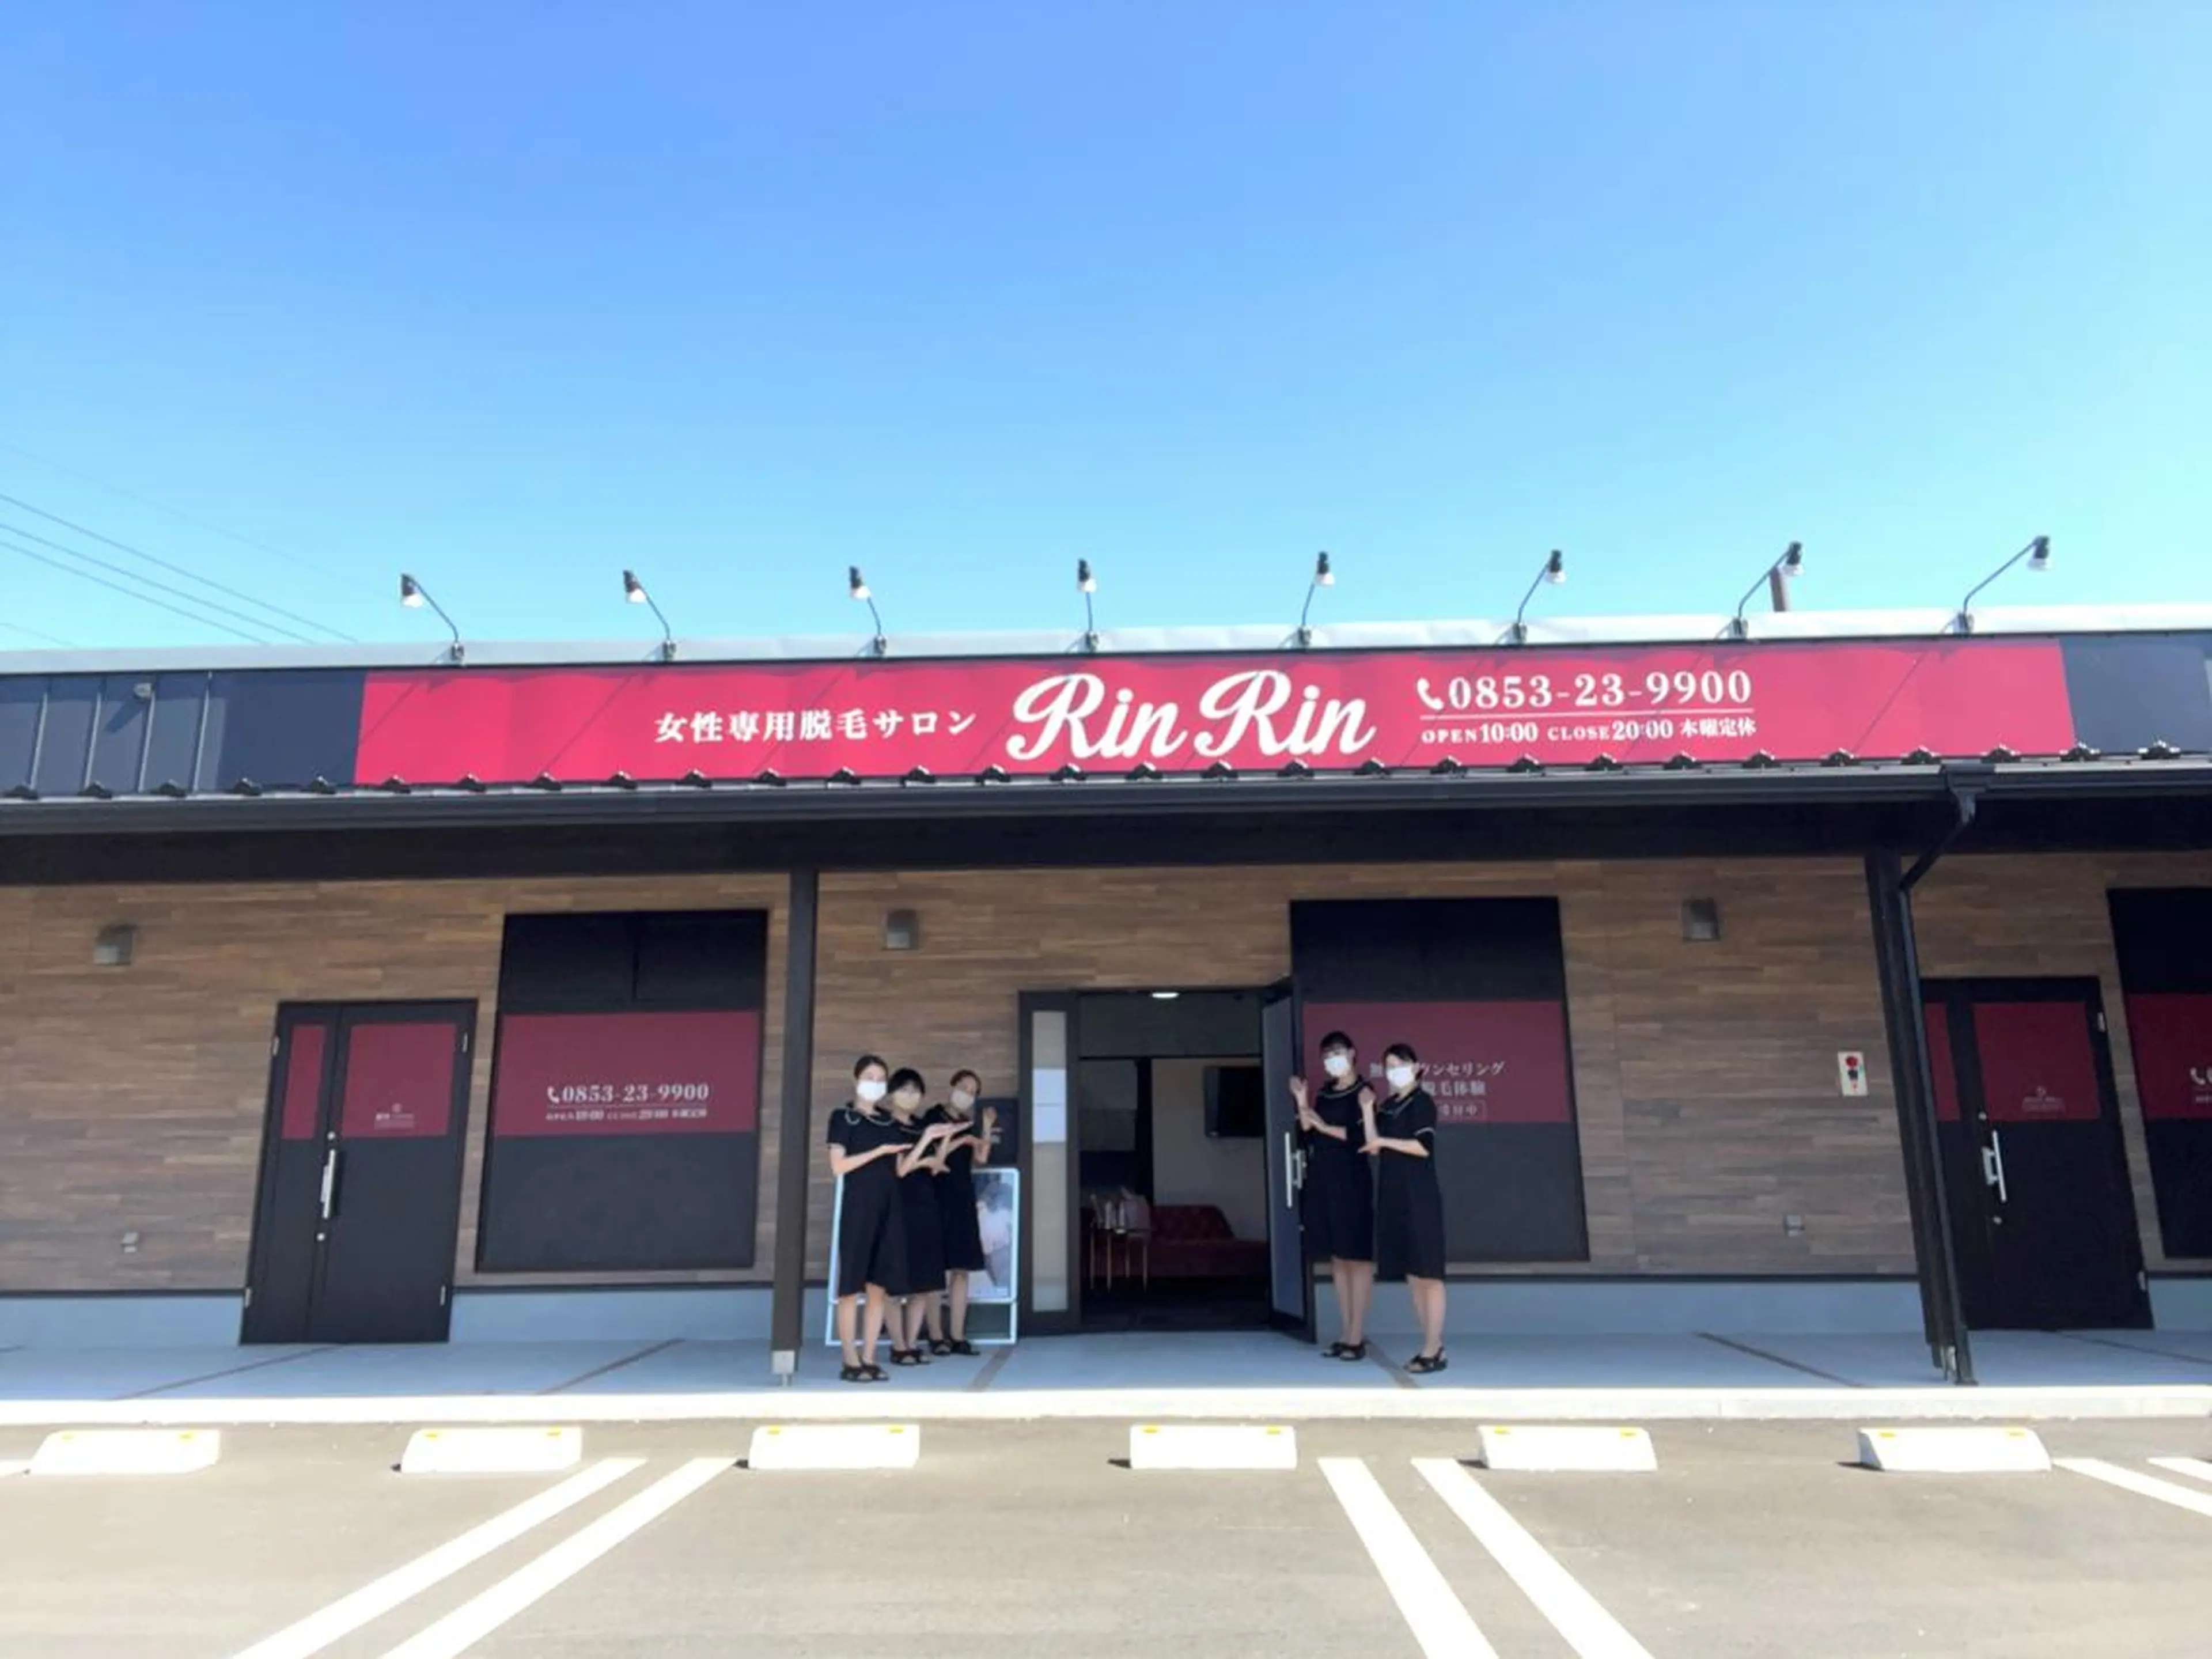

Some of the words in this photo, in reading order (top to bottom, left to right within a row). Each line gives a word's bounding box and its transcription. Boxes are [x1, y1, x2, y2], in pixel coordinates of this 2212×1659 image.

[1448, 671, 1752, 709] 0853-23-9900
[656, 709, 975, 742] 女性専用脱毛サロン
[1006, 673, 1188, 760] Rin
[1194, 669, 1376, 757] Rin
[1680, 717, 1756, 737] 木曜定休
[562, 1084, 709, 1103] 0853-23-9900
